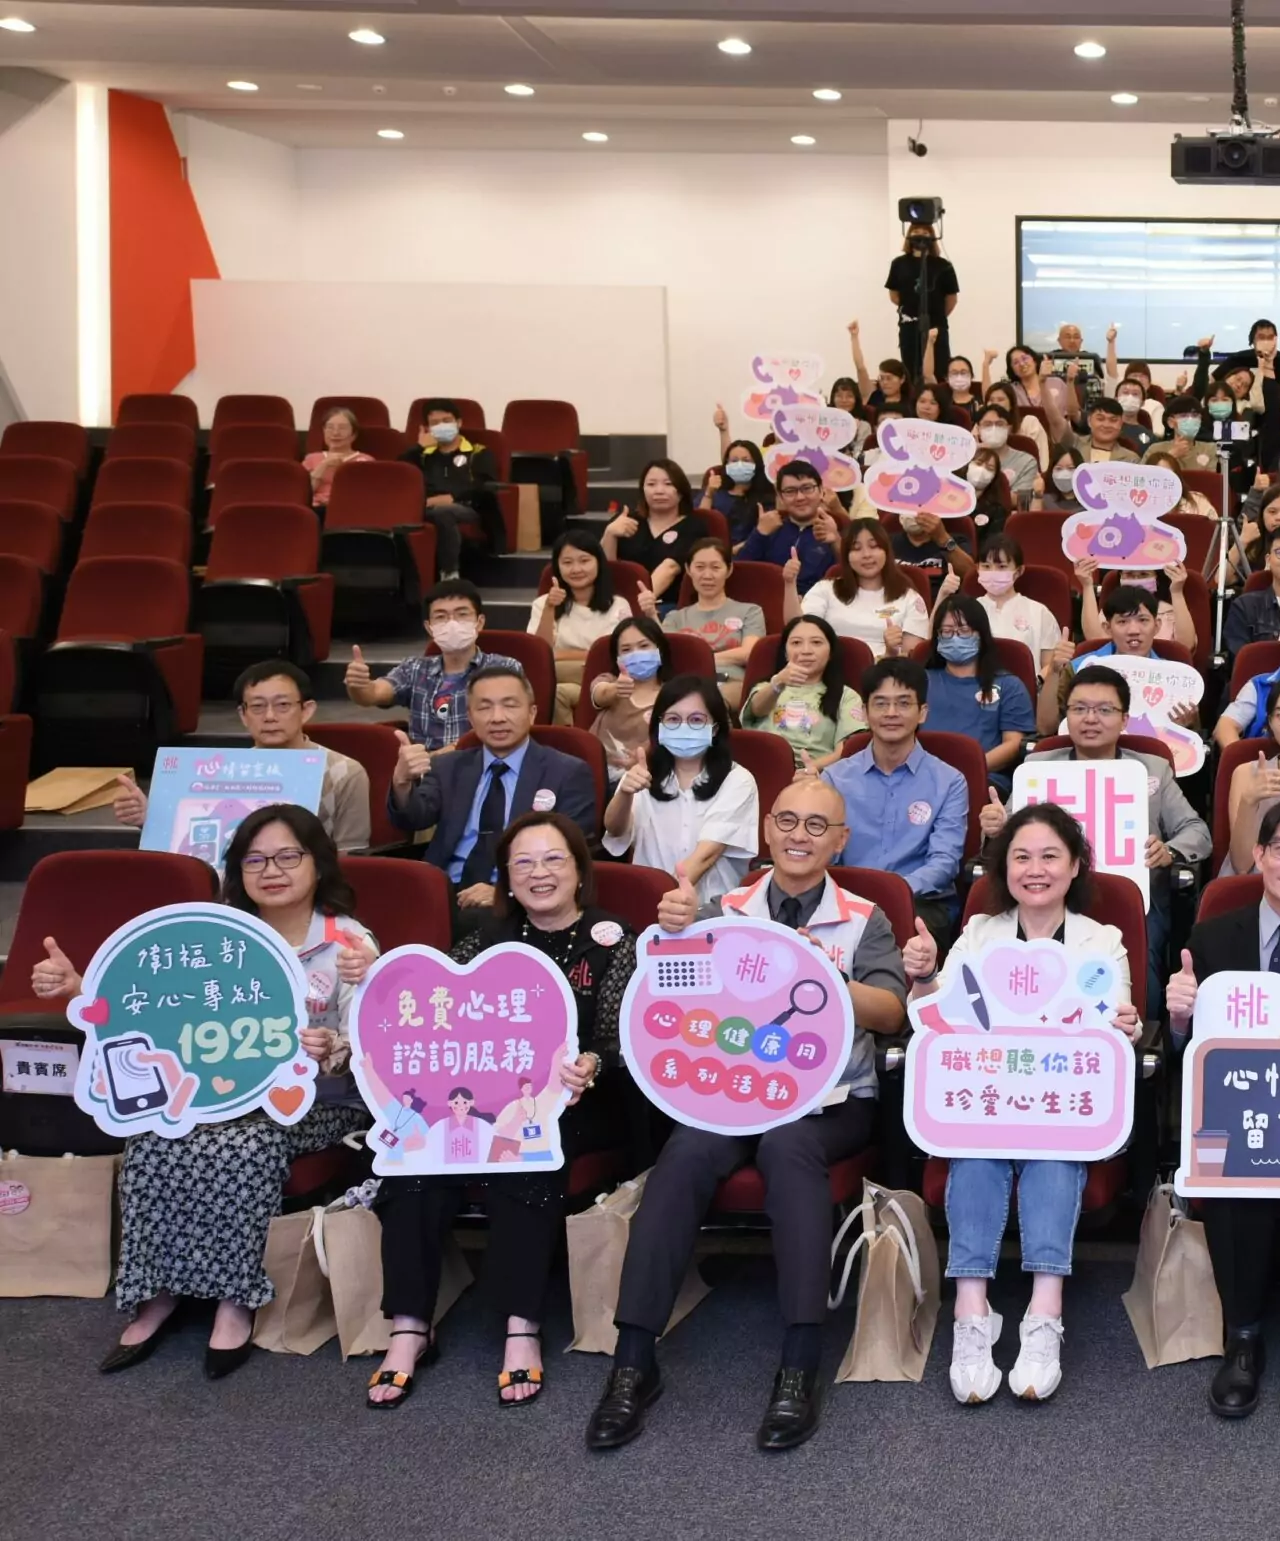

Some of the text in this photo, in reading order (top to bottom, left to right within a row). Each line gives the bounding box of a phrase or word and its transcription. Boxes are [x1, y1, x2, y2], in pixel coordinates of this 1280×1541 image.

[138, 937, 247, 970] 衛福部
[121, 976, 271, 1012] 安心專線
[397, 987, 534, 1032] 免費心理
[178, 1016, 294, 1064] 1925
[653, 1012, 817, 1060] 心理健康月
[17, 1060, 68, 1078] 貴賓席
[391, 1037, 535, 1077] 諮詢服務
[940, 1047, 1101, 1076] 職想聽你說
[662, 1058, 789, 1101] 系列活動
[944, 1084, 1095, 1117] 珍愛心生活
